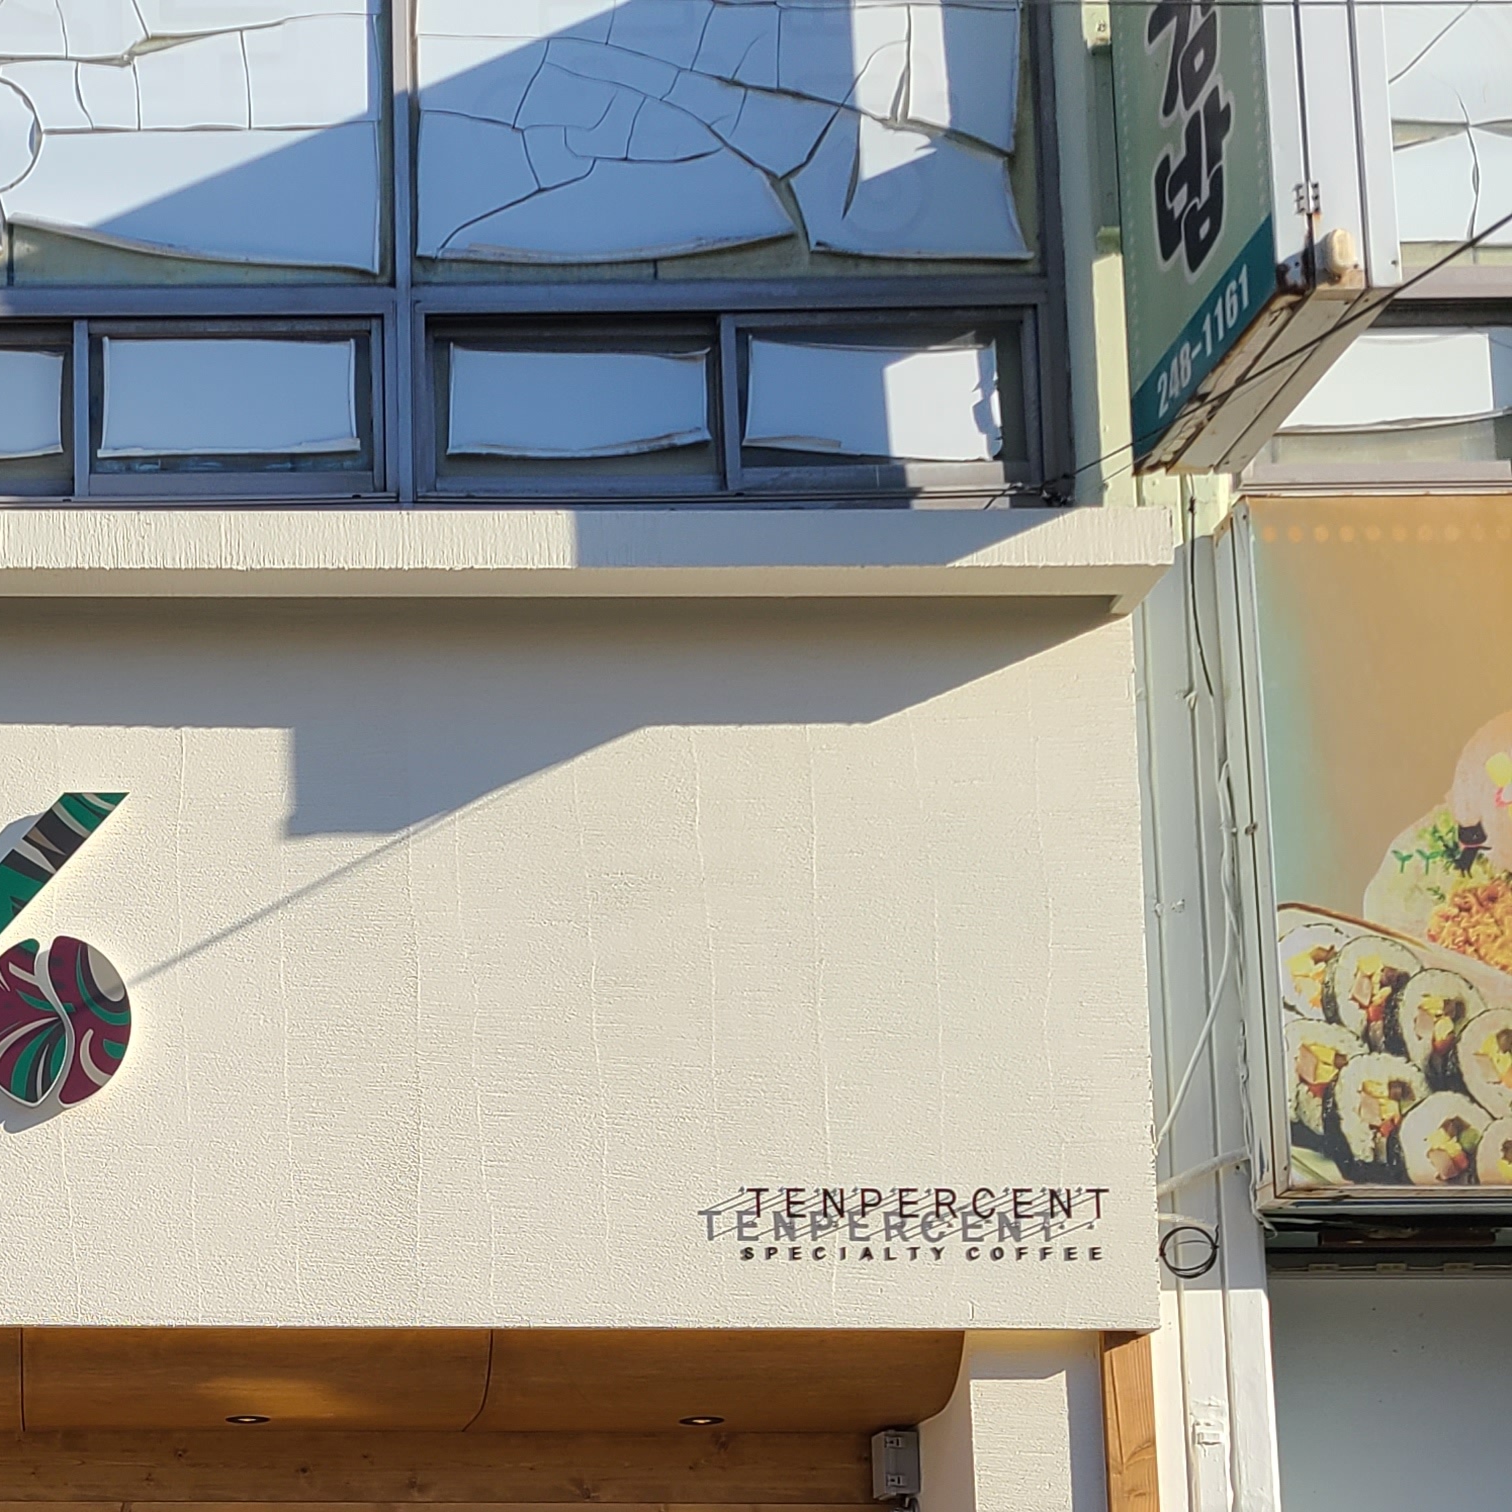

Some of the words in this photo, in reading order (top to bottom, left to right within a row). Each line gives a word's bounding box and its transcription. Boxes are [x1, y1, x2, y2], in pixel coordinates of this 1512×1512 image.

[746, 1188, 1110, 1219] TENPERCENT
[741, 1246, 944, 1261] SPECIALTY
[966, 1246, 1104, 1261] COFFEE
